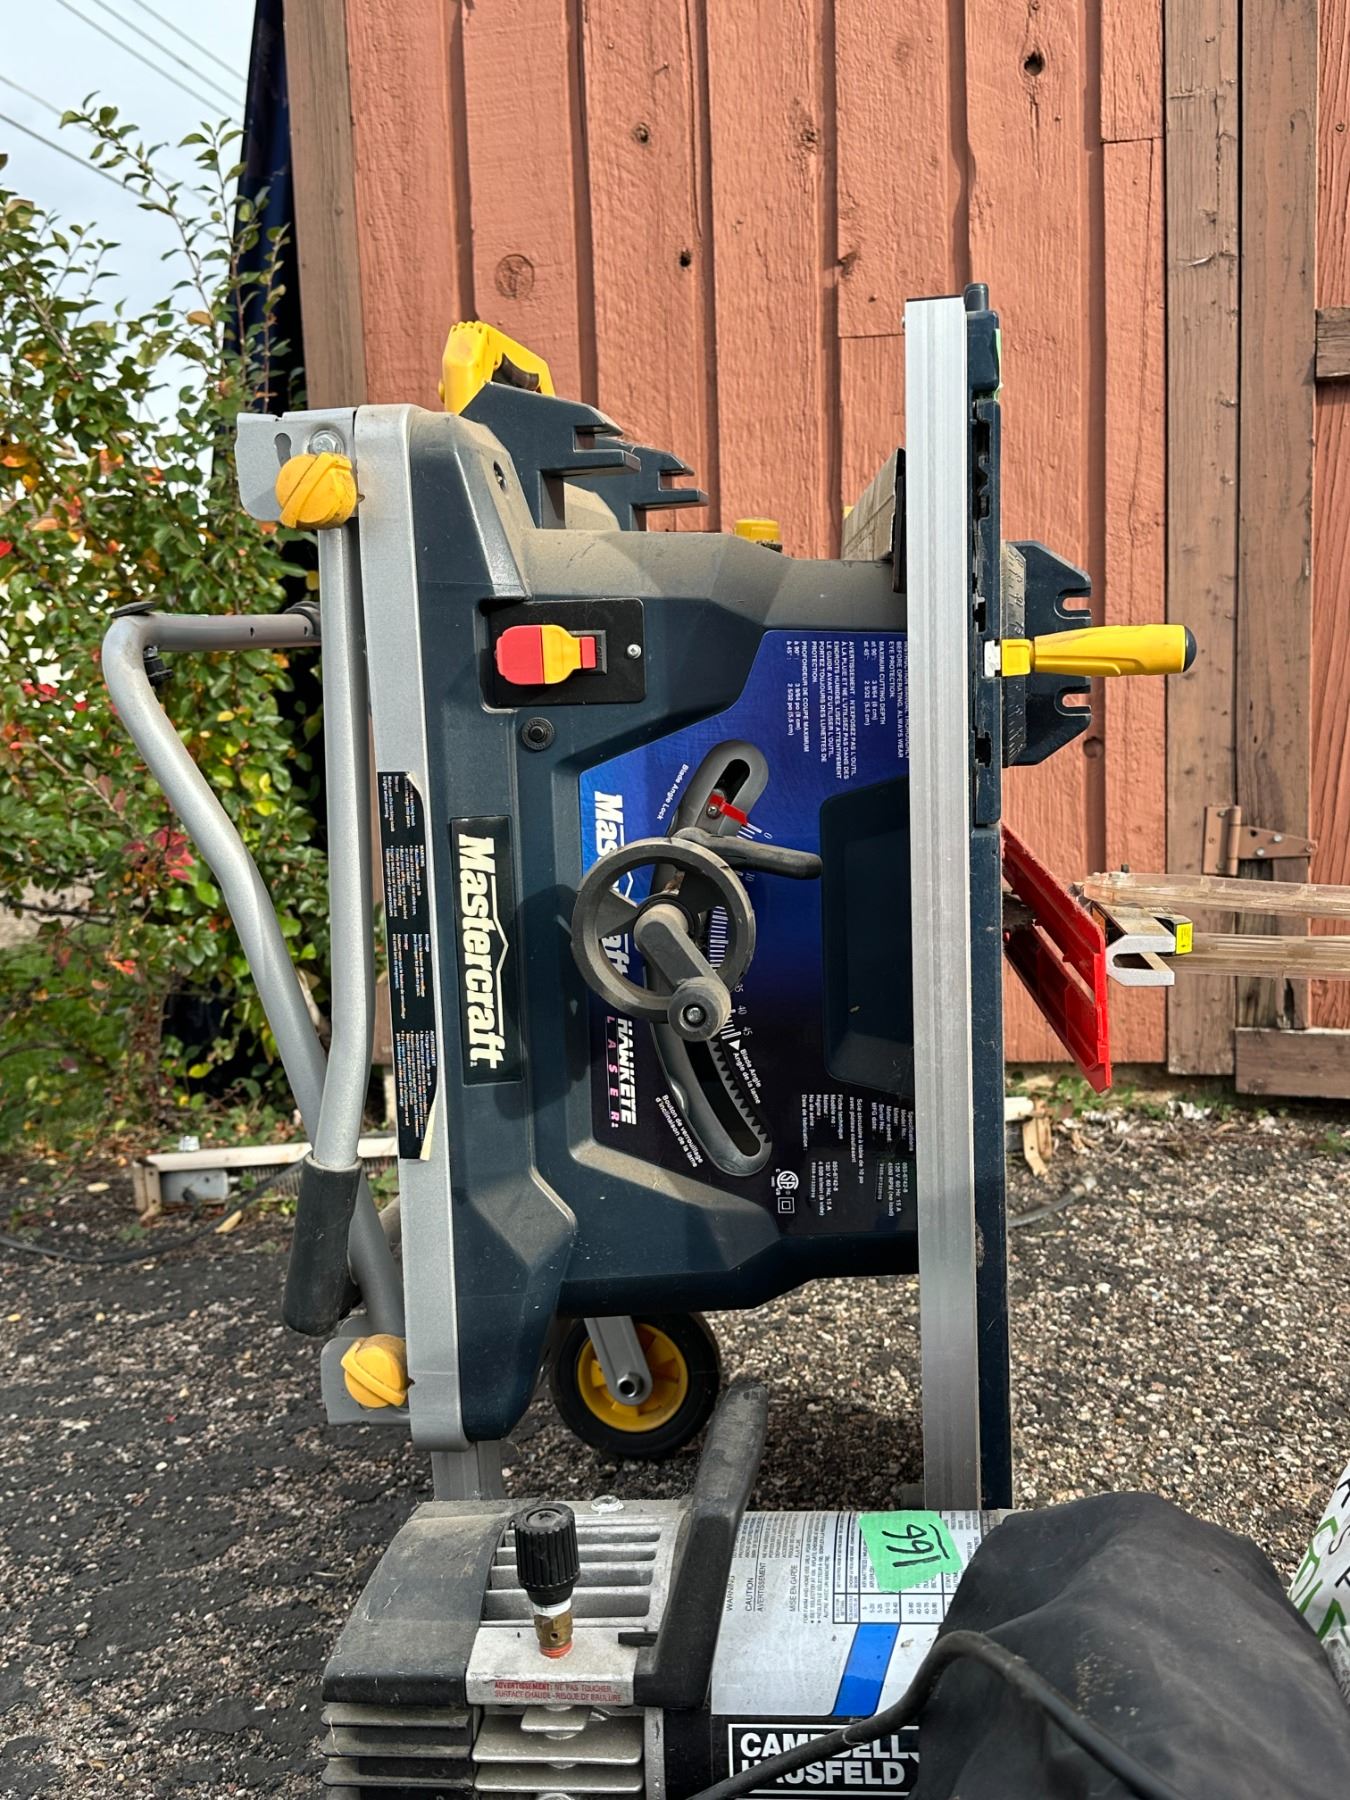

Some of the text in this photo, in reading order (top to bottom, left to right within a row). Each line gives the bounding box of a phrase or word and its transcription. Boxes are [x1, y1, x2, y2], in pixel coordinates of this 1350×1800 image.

[826, 641, 832, 649] LE
[842, 648, 847, 656] LA
[802, 687, 808, 696] DE
[842, 688, 848, 696] NE
[821, 754, 827, 762] DE
[656, 764, 688, 820] Blade Angle Lock
[594, 791, 630, 977] Masaft
[746, 873, 754, 881] 10
[458, 834, 505, 1068] Mastercraft
[738, 1005, 747, 1014] 40
[743, 1027, 753, 1036] 45
[607, 1016, 620, 1120] LASER
[617, 1018, 636, 1125] HAWKEYE
[733, 1052, 745, 1071] Angle
[743, 1072, 749, 1080] de
[750, 1088, 760, 1104] lame
[740, 1049, 761, 1087] Blade Angle
[809, 1094, 814, 1102] No
[656, 1097, 680, 1136] d'inclinaison
[678, 1136, 684, 1145] de
[687, 1152, 697, 1167] lame
[662, 1095, 703, 1163] Bouton de verrouillage
[858, 1176, 864, 1184] po
[726, 1576, 734, 1611] WARNING
[745, 1578, 753, 1611] CAUTION
[758, 1562, 766, 1611] AVERTISSEMENT
[790, 1586, 796, 1594] EN
[495, 1690, 523, 1698] SURFACE
[565, 1684, 578, 1692] PAS
[740, 1732, 910, 1760] CAMELL
[742, 1760, 905, 1785] USFELD
